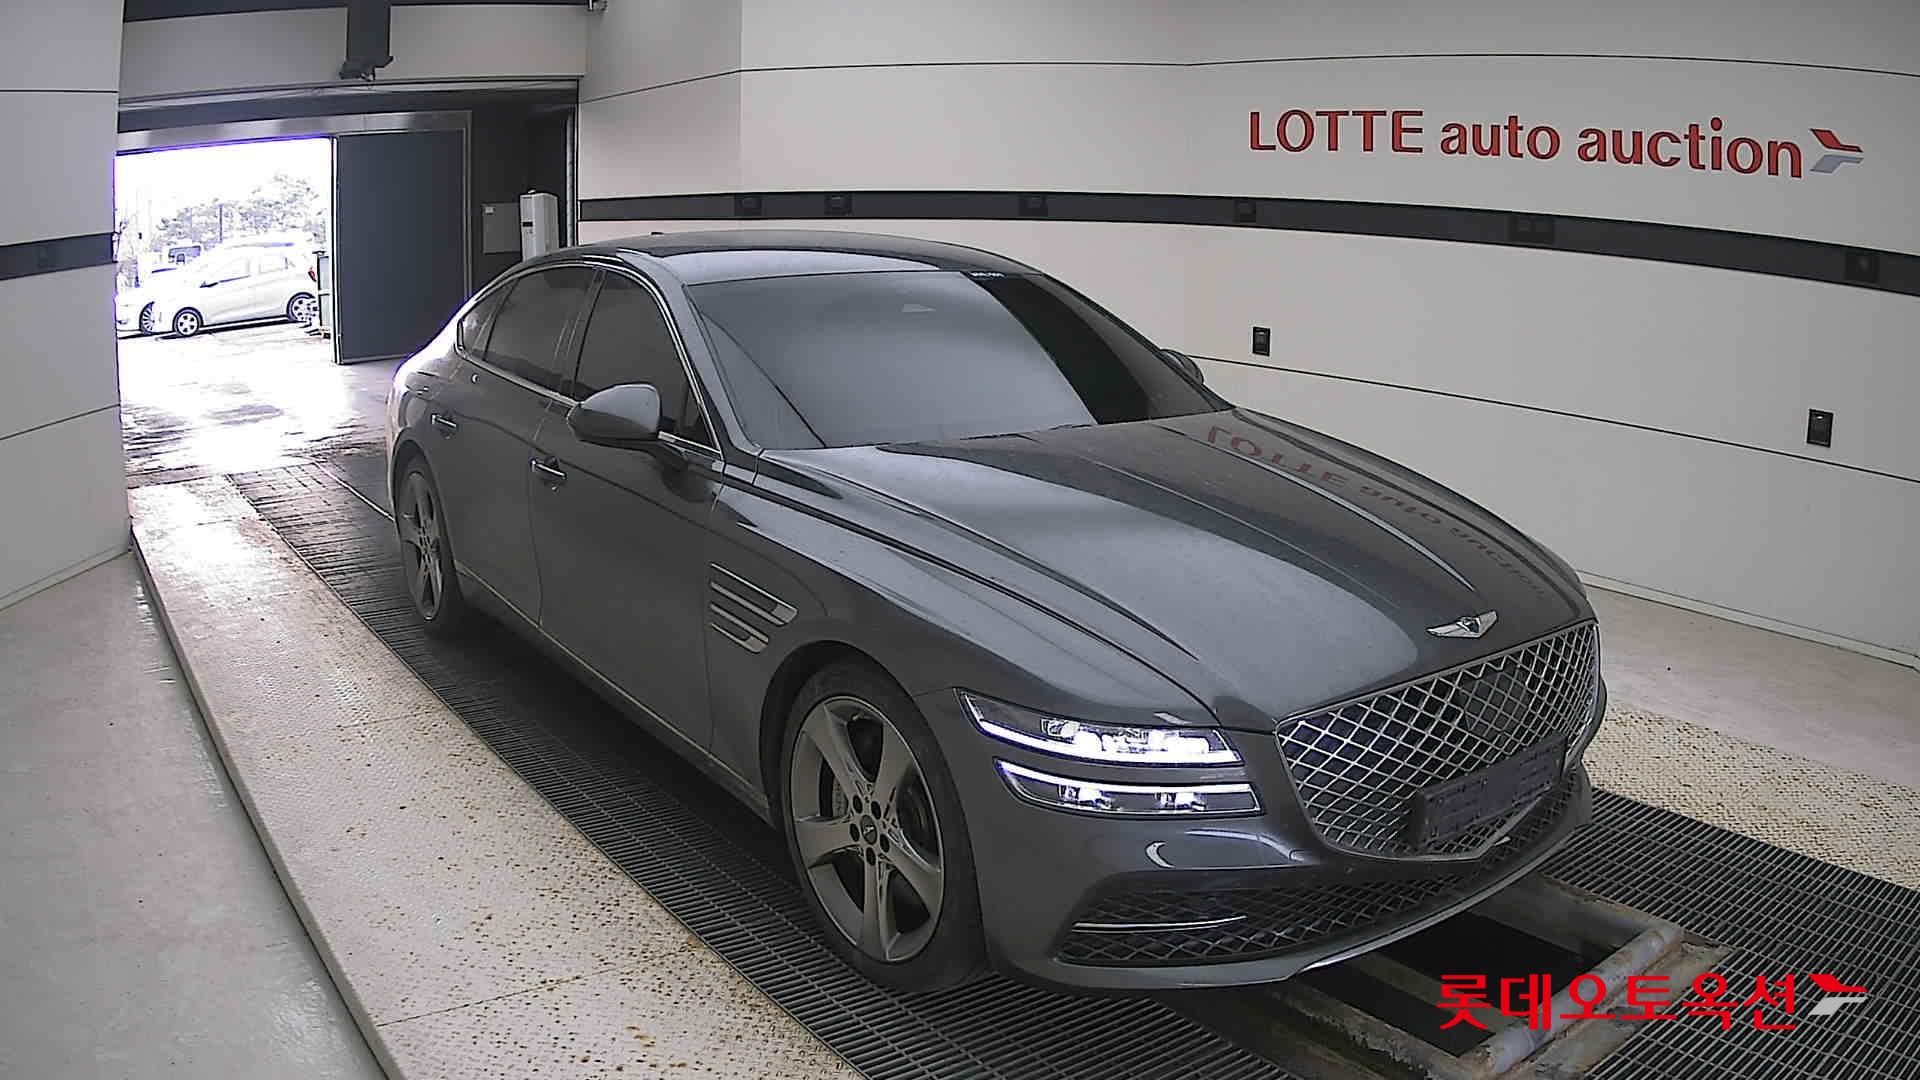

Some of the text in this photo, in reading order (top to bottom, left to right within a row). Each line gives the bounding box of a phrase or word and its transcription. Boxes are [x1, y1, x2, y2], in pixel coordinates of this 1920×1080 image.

[1248, 111, 1803, 178] LOTTE auto auction
